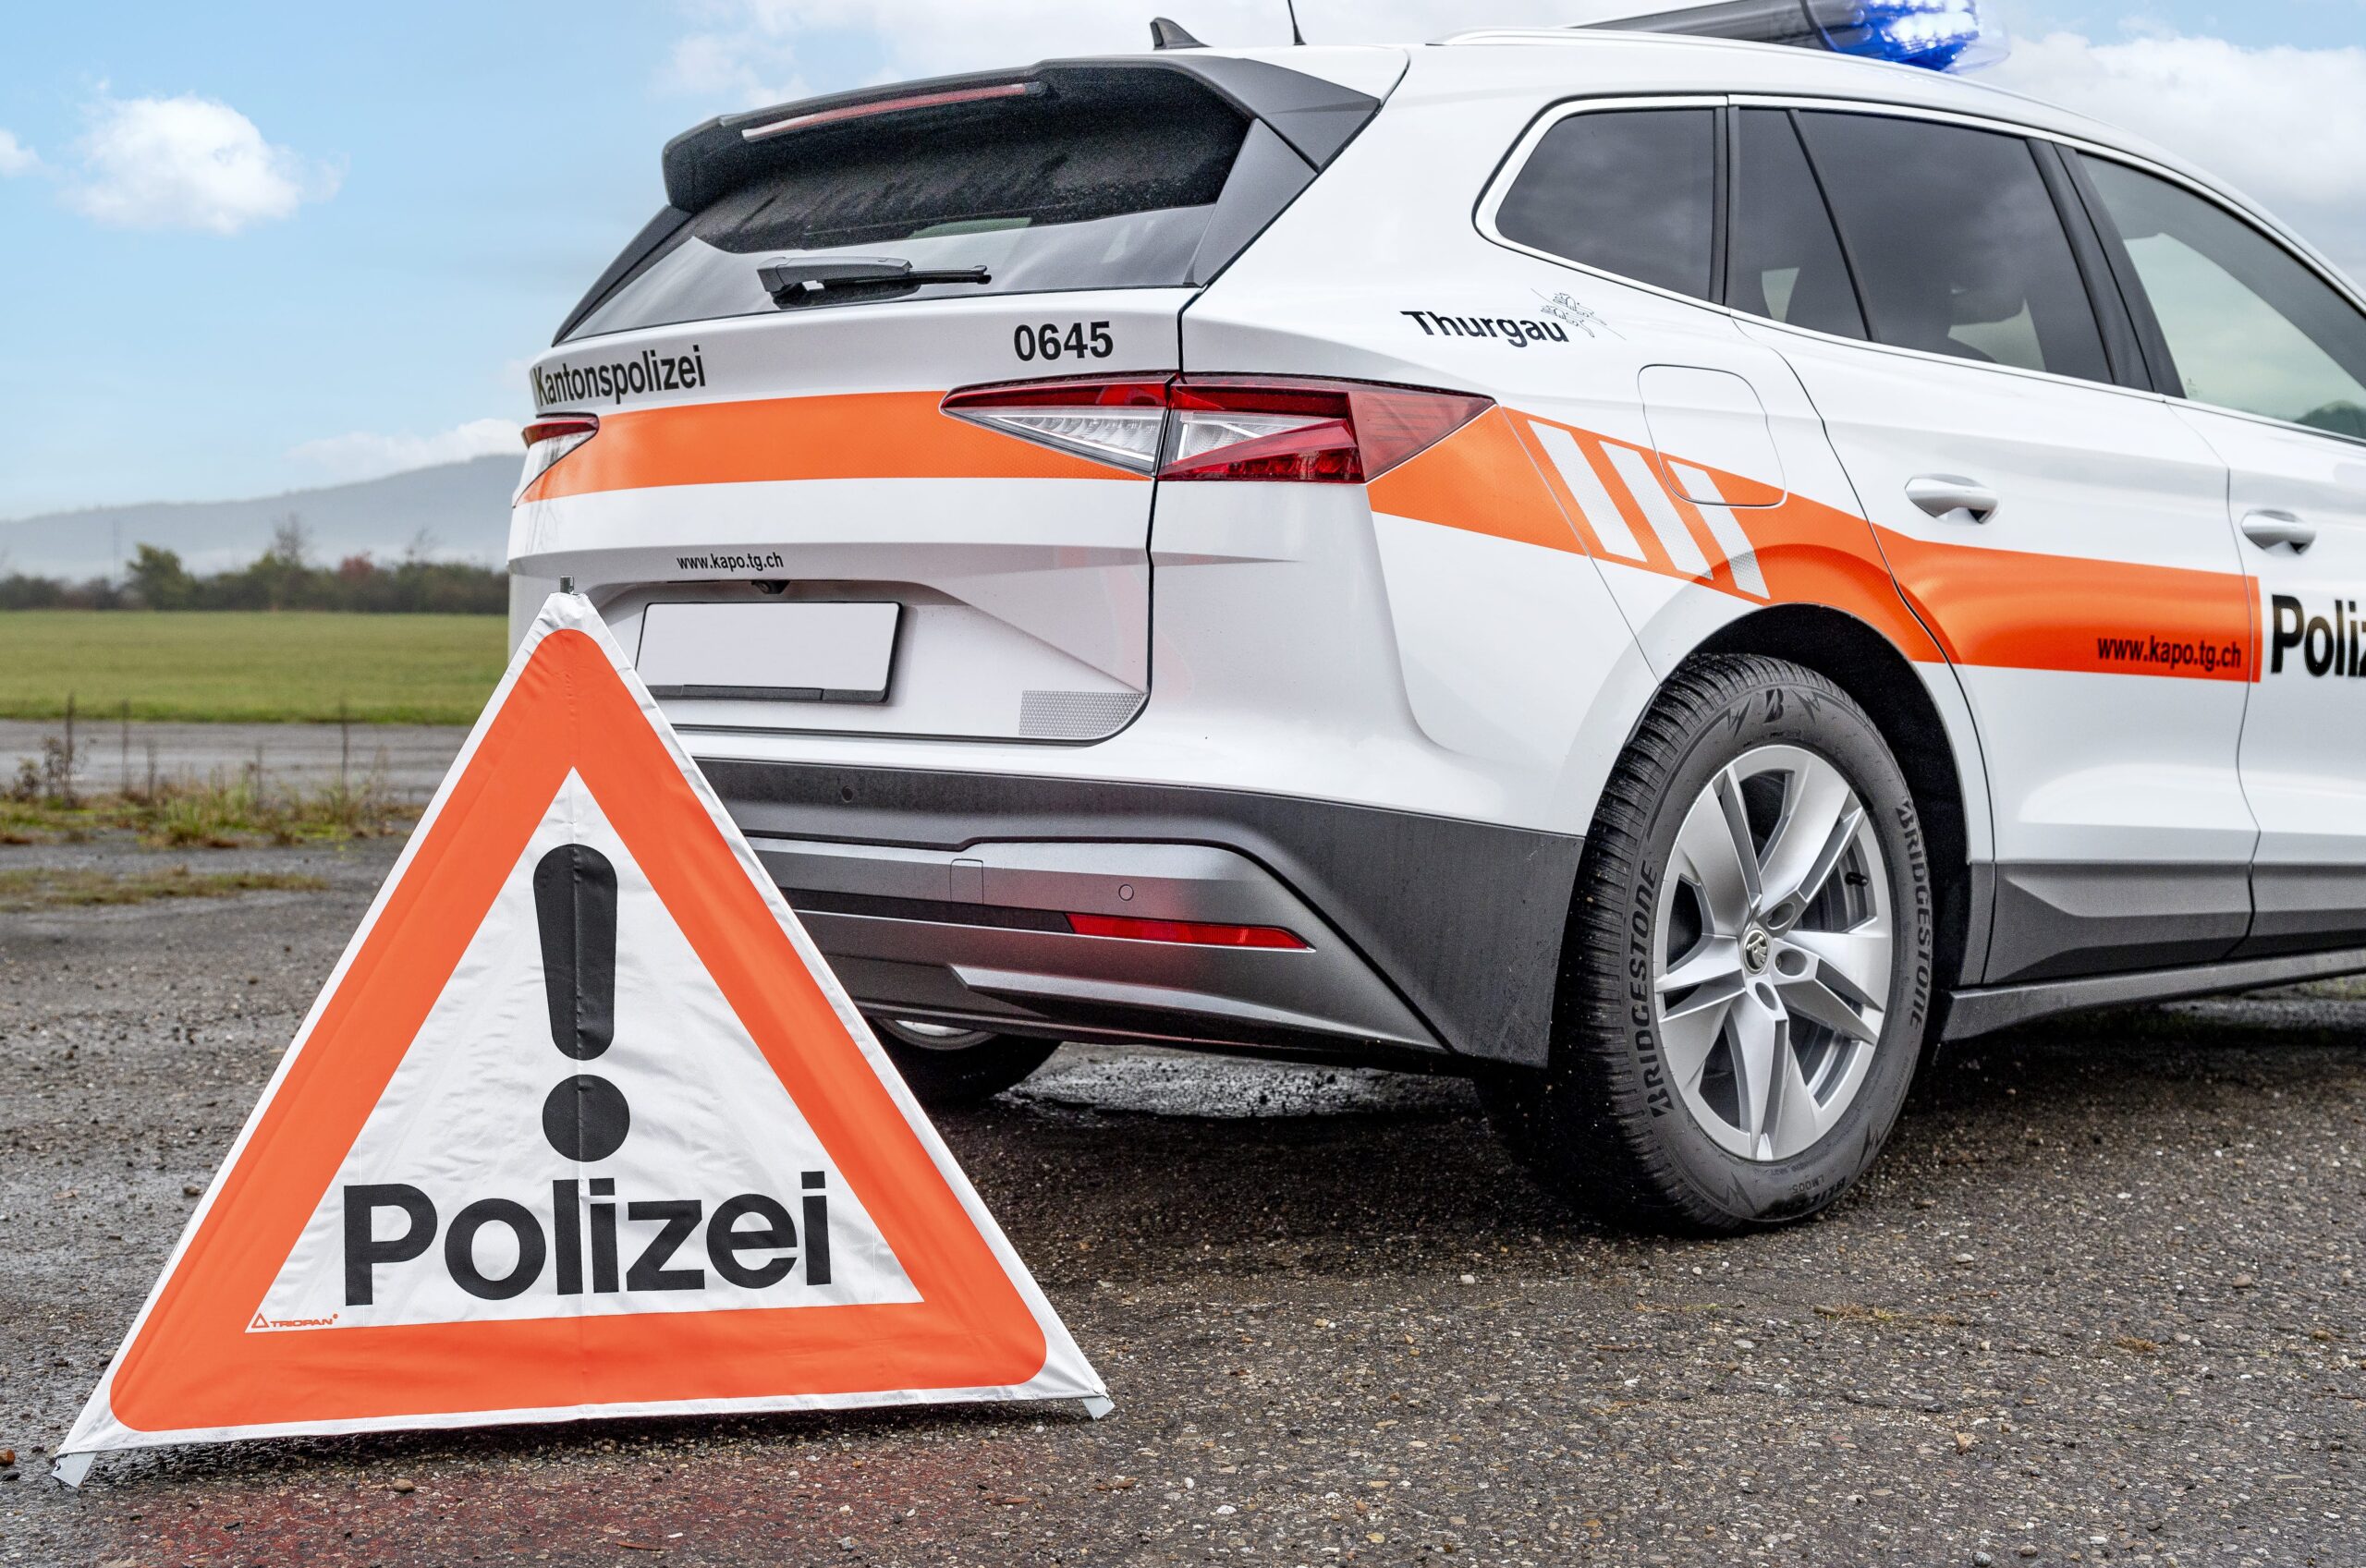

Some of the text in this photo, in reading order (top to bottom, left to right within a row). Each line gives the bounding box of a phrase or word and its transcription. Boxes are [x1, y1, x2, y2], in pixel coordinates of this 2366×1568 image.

[1014, 321, 1115, 362] 0645
[1400, 310, 1569, 347] Thurgau
[532, 345, 706, 407] Kantonspolizei
[677, 552, 784, 572] www.kapo.tg.ch
[2097, 636, 2241, 672] www.kapo.tg.ch
[1896, 800, 1931, 1030] BRIDGESTONE
[1628, 859, 1674, 1118] BRIDGESTONE
[343, 1171, 832, 1306] Polizei
[270, 1319, 334, 1328] TRIOPAN
